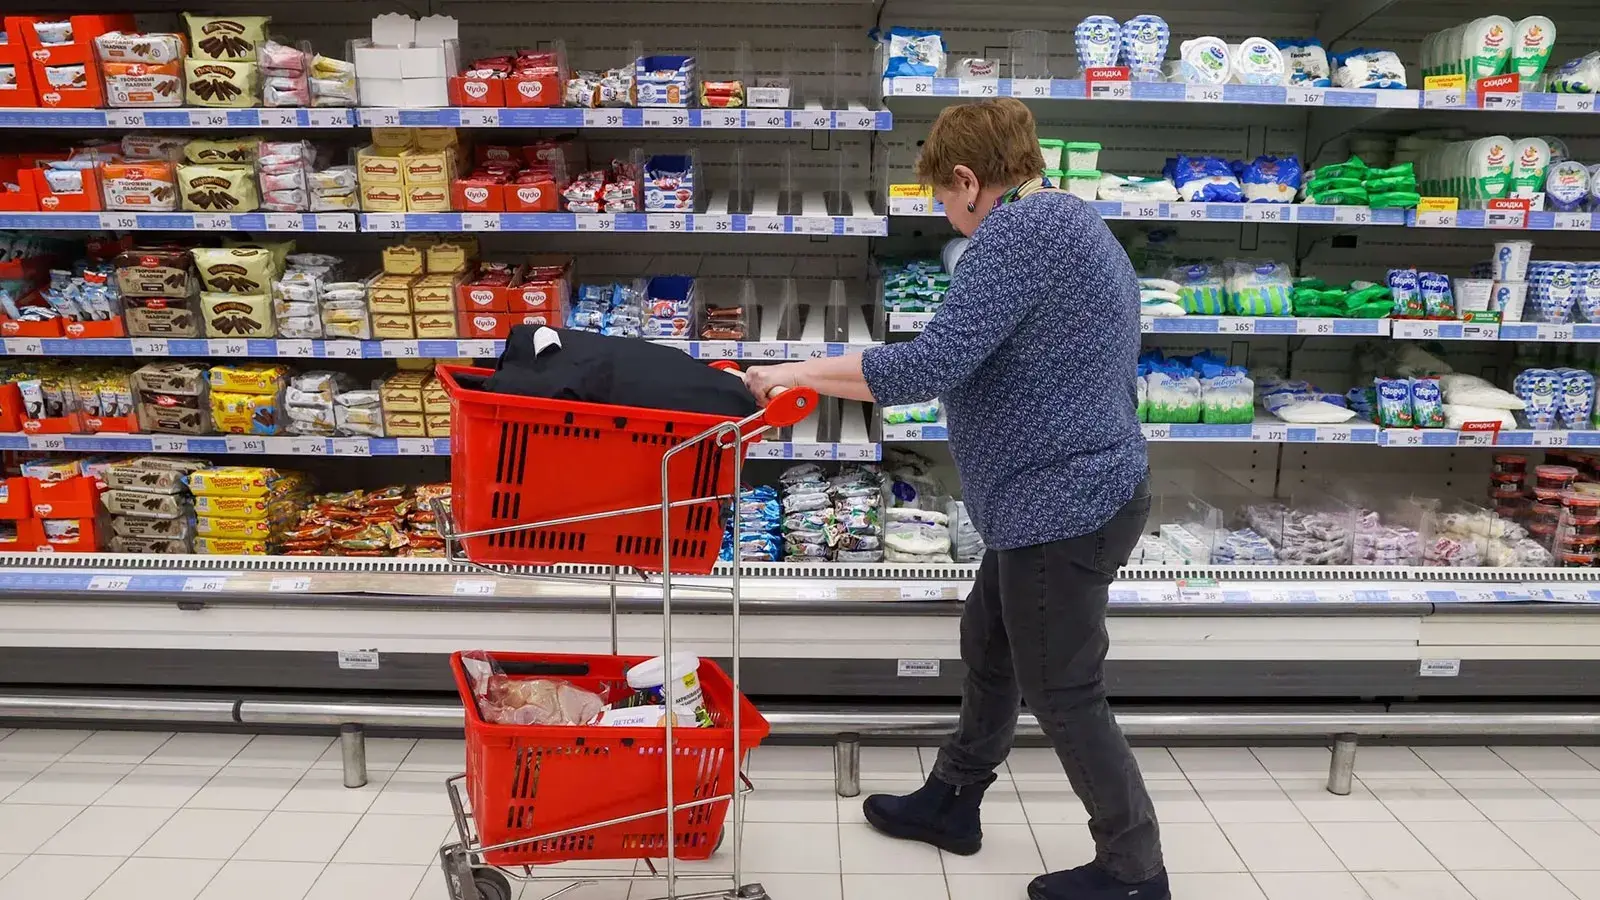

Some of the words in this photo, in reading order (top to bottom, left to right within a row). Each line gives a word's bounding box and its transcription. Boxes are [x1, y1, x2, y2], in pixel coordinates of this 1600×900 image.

[915, 83, 927, 92] 82
[1483, 78, 1512, 88] СКИДКА
[466, 85, 486, 96] Чудо
[520, 85, 540, 96] Чудо
[982, 86, 993, 94] 75
[1034, 86, 1046, 95] 91
[1113, 88, 1124, 97] 99
[1202, 91, 1219, 100] 145
[1304, 94, 1319, 103] 167
[1446, 95, 1456, 104] 56
[1505, 99, 1516, 108] 79
[1576, 101, 1588, 110] 90
[124, 116, 140, 125] 150
[207, 116, 223, 125] 149
[280, 116, 292, 124] 24
[330, 116, 342, 126] 24
[384, 116, 394, 124] 31
[482, 116, 494, 124] 34
[606, 116, 618, 124] 39
[672, 116, 684, 125] 39
[724, 117, 736, 126] 39
[767, 117, 780, 126] 40
[813, 117, 826, 126] 49
[858, 118, 870, 127] 49
[467, 190, 487, 201] Чудо
[520, 190, 539, 202] Чудо
[912, 204, 924, 212] 43
[1138, 208, 1154, 216] 156
[1261, 211, 1276, 219] 156
[1355, 213, 1366, 222] 85
[118, 219, 133, 228] 150
[211, 219, 226, 228] 149
[287, 220, 299, 228] 24
[338, 220, 349, 229] 24
[390, 220, 400, 228] 31
[484, 220, 496, 228] 34
[599, 220, 610, 228] 39
[1438, 216, 1449, 224] 56
[1508, 216, 1519, 224] 79
[669, 221, 681, 229] 39
[716, 221, 727, 230] 35
[767, 223, 779, 231] 44
[1235, 323, 1249, 331] 165
[1423, 329, 1434, 337] 95
[1482, 329, 1494, 338] 92
[1553, 331, 1568, 339] 133
[27, 344, 36, 352] 47
[150, 344, 164, 352] 137
[298, 346, 308, 355] 24
[346, 347, 357, 356] 24
[404, 347, 414, 355] 31
[479, 347, 490, 355] 34
[722, 349, 733, 357] 36
[763, 349, 775, 357] 40
[810, 350, 822, 358] 42
[906, 430, 917, 438] 86
[1150, 430, 1166, 438] 190
[1268, 431, 1282, 440] 171
[1332, 432, 1346, 441] 229
[243, 441, 256, 449] 161
[814, 450, 826, 458] 49
[859, 449, 869, 458] 31
[612, 717, 644, 726] ДЕТСКИЕ
